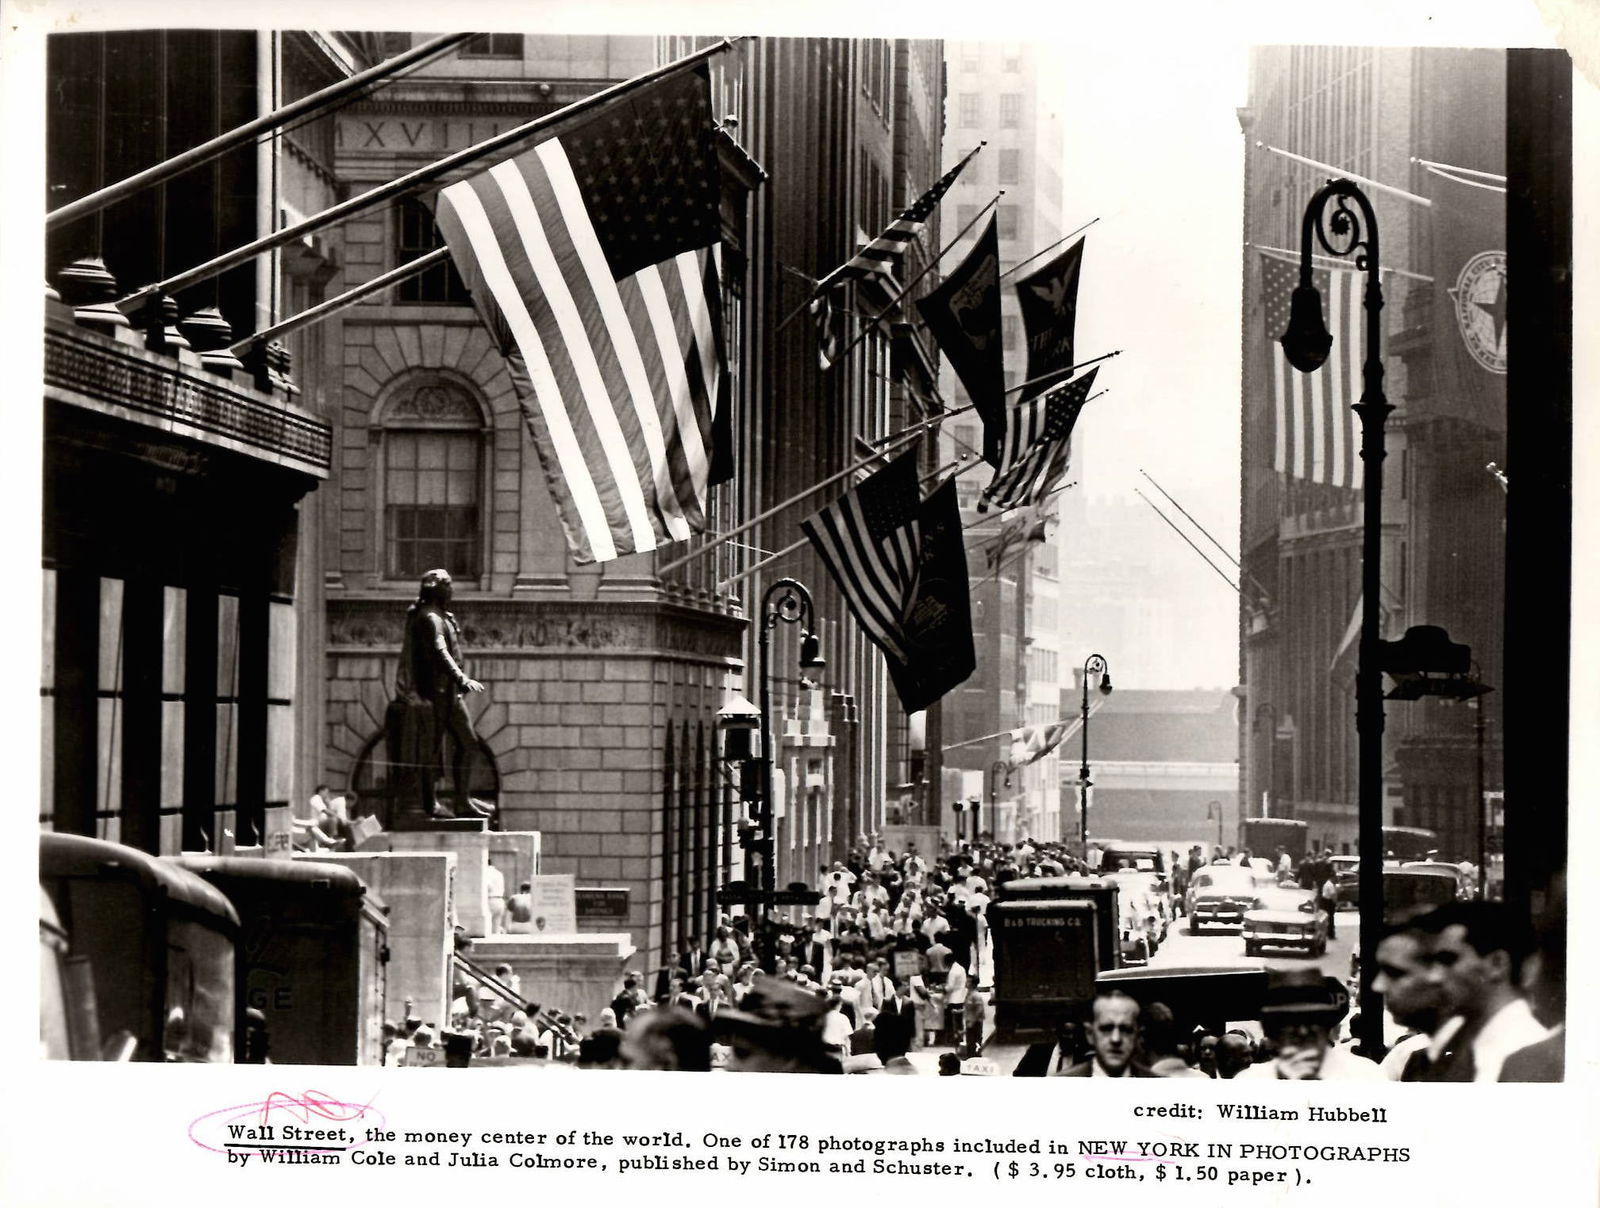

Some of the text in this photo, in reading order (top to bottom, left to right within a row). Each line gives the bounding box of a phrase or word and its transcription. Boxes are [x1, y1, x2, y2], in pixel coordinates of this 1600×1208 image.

[1026, 917, 1065, 928] TRUCKING
[416, 1051, 436, 1062] NO
[967, 1063, 995, 1074] TAXI
